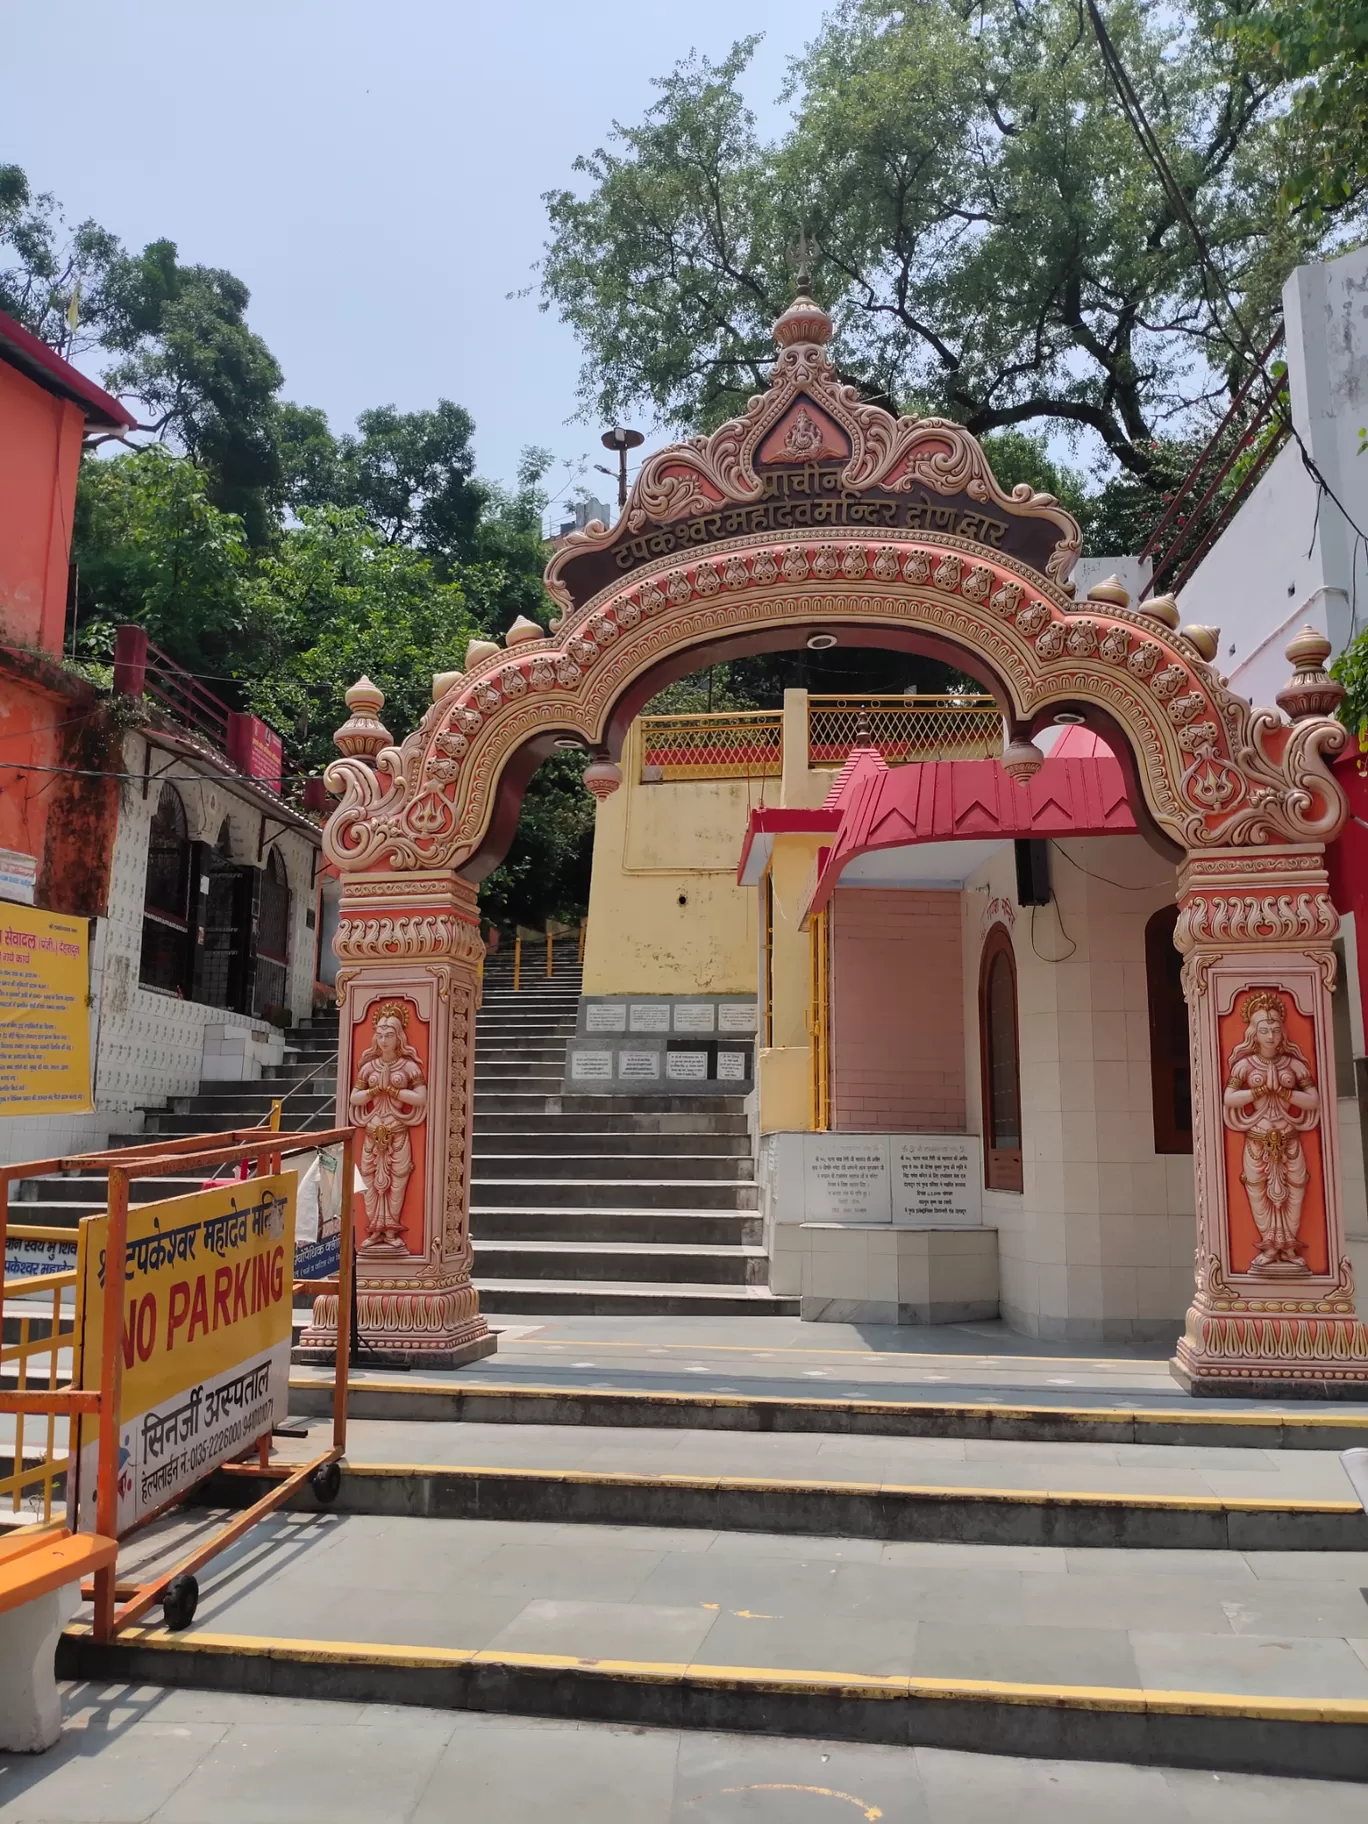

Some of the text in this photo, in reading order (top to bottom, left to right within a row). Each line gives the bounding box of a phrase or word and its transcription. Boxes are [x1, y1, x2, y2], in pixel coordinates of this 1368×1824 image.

[760, 461, 844, 499] प्राचीन
[955, 509, 1009, 549] द्वार
[5, 926, 36, 949] सेवादल
[125, 1217, 201, 1281] टपकेश्वर
[204, 1197, 251, 1258] महादेव
[5, 1256, 39, 1275] पकेश्वर
[121, 1292, 157, 1370] NO
[166, 1245, 285, 1352] PARKING
[141, 1359, 272, 1465] सिनर्जी अस्पताल
[141, 1453, 180, 1504] हेल्पलाईन
